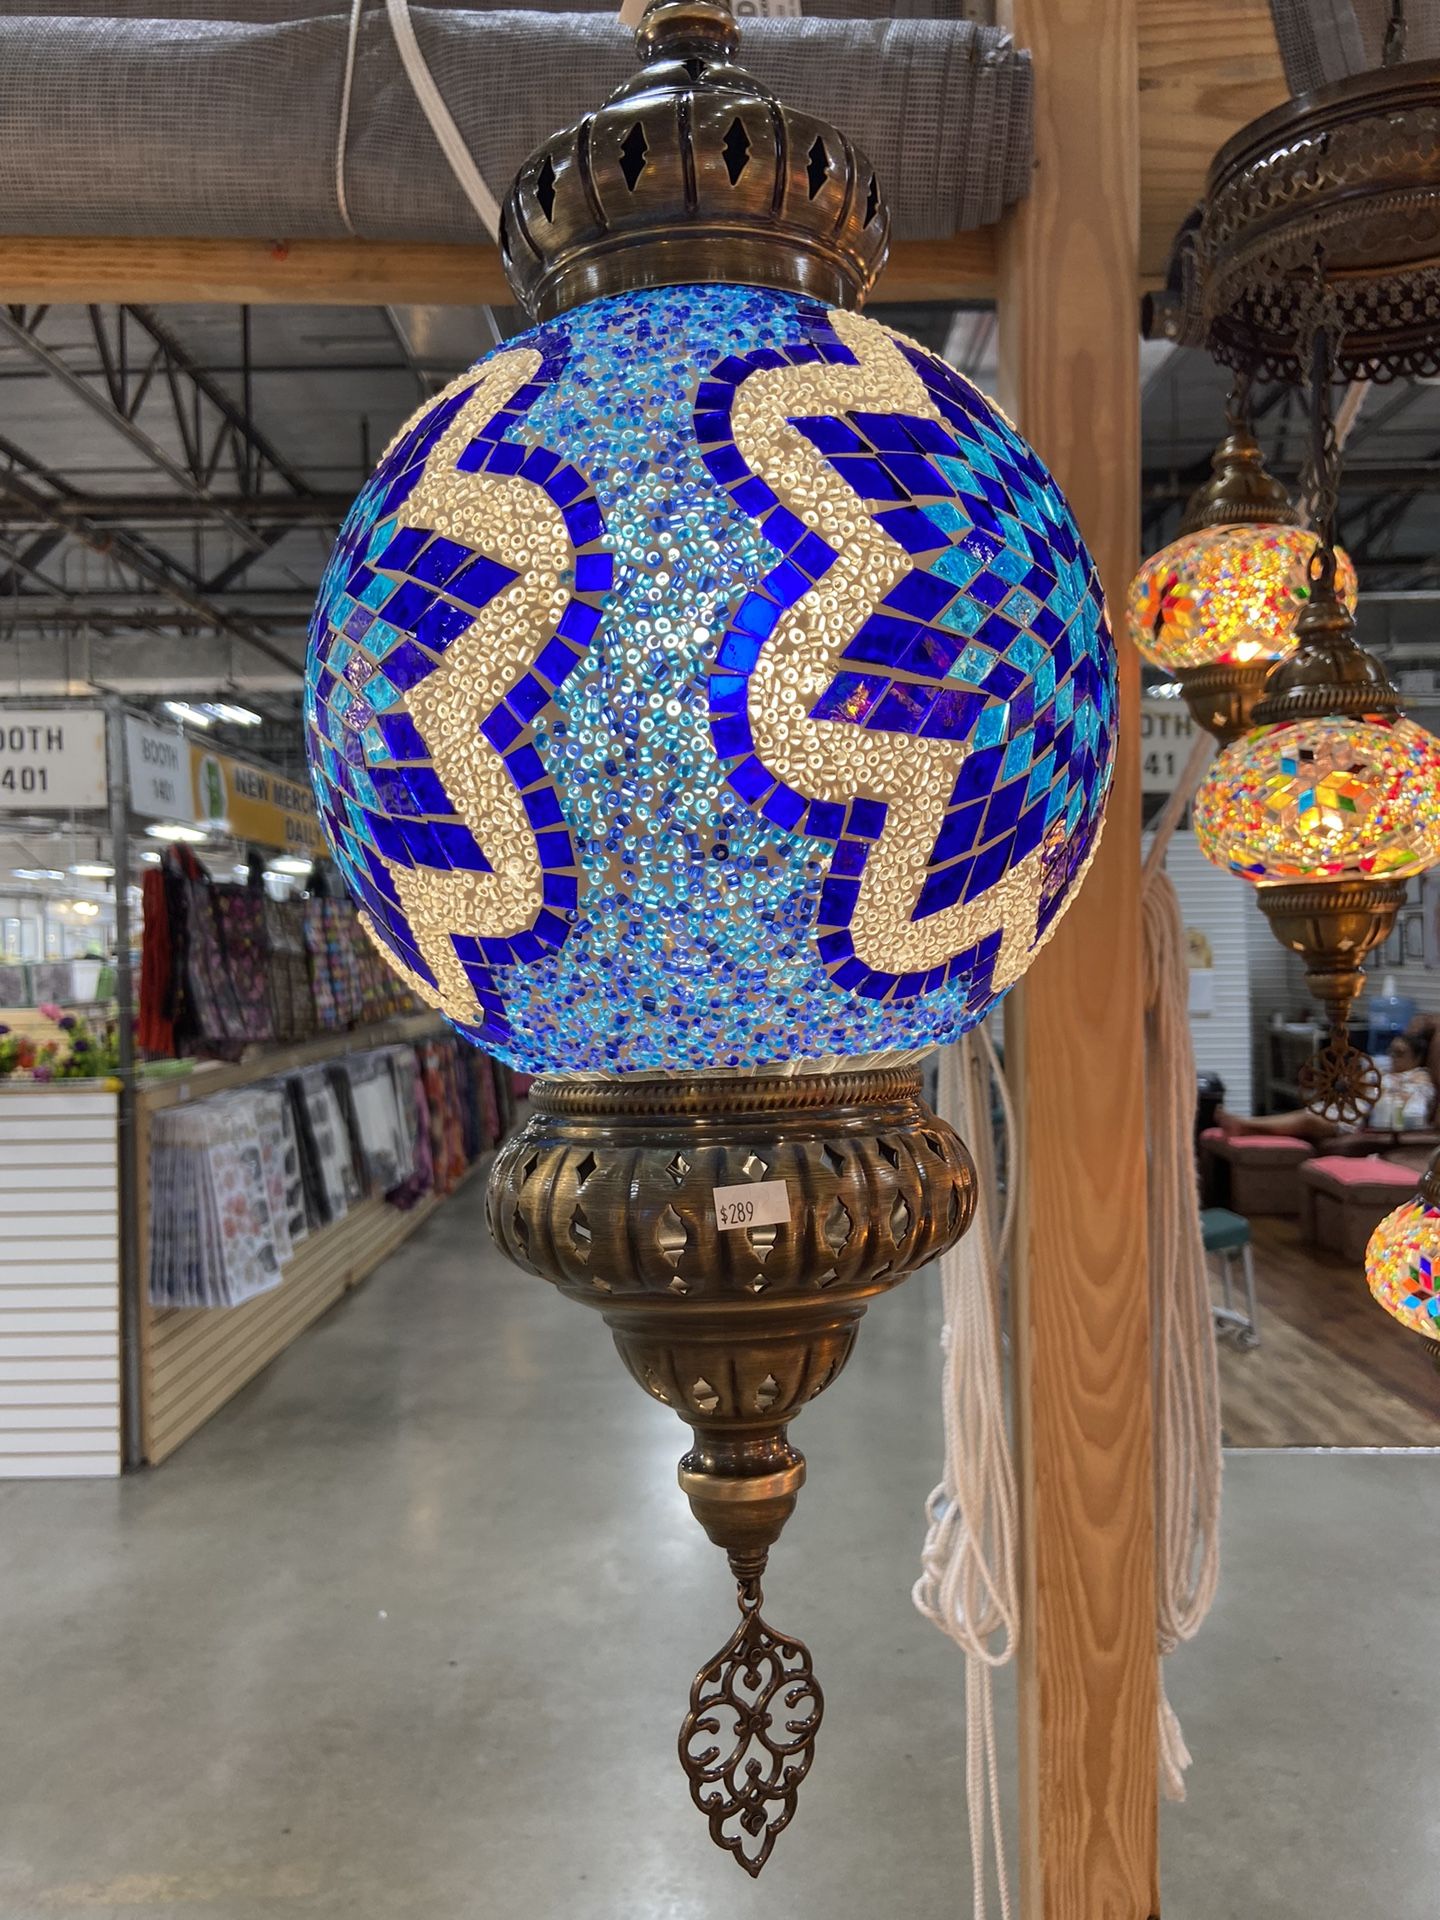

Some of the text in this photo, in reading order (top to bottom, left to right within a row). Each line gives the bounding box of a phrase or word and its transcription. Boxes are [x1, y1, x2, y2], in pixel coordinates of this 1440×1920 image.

[142, 736, 180, 771] BOOTH
[1, 768, 47, 791] 401
[235, 765, 268, 801] NEW
[720, 1201, 754, 1225] $289
